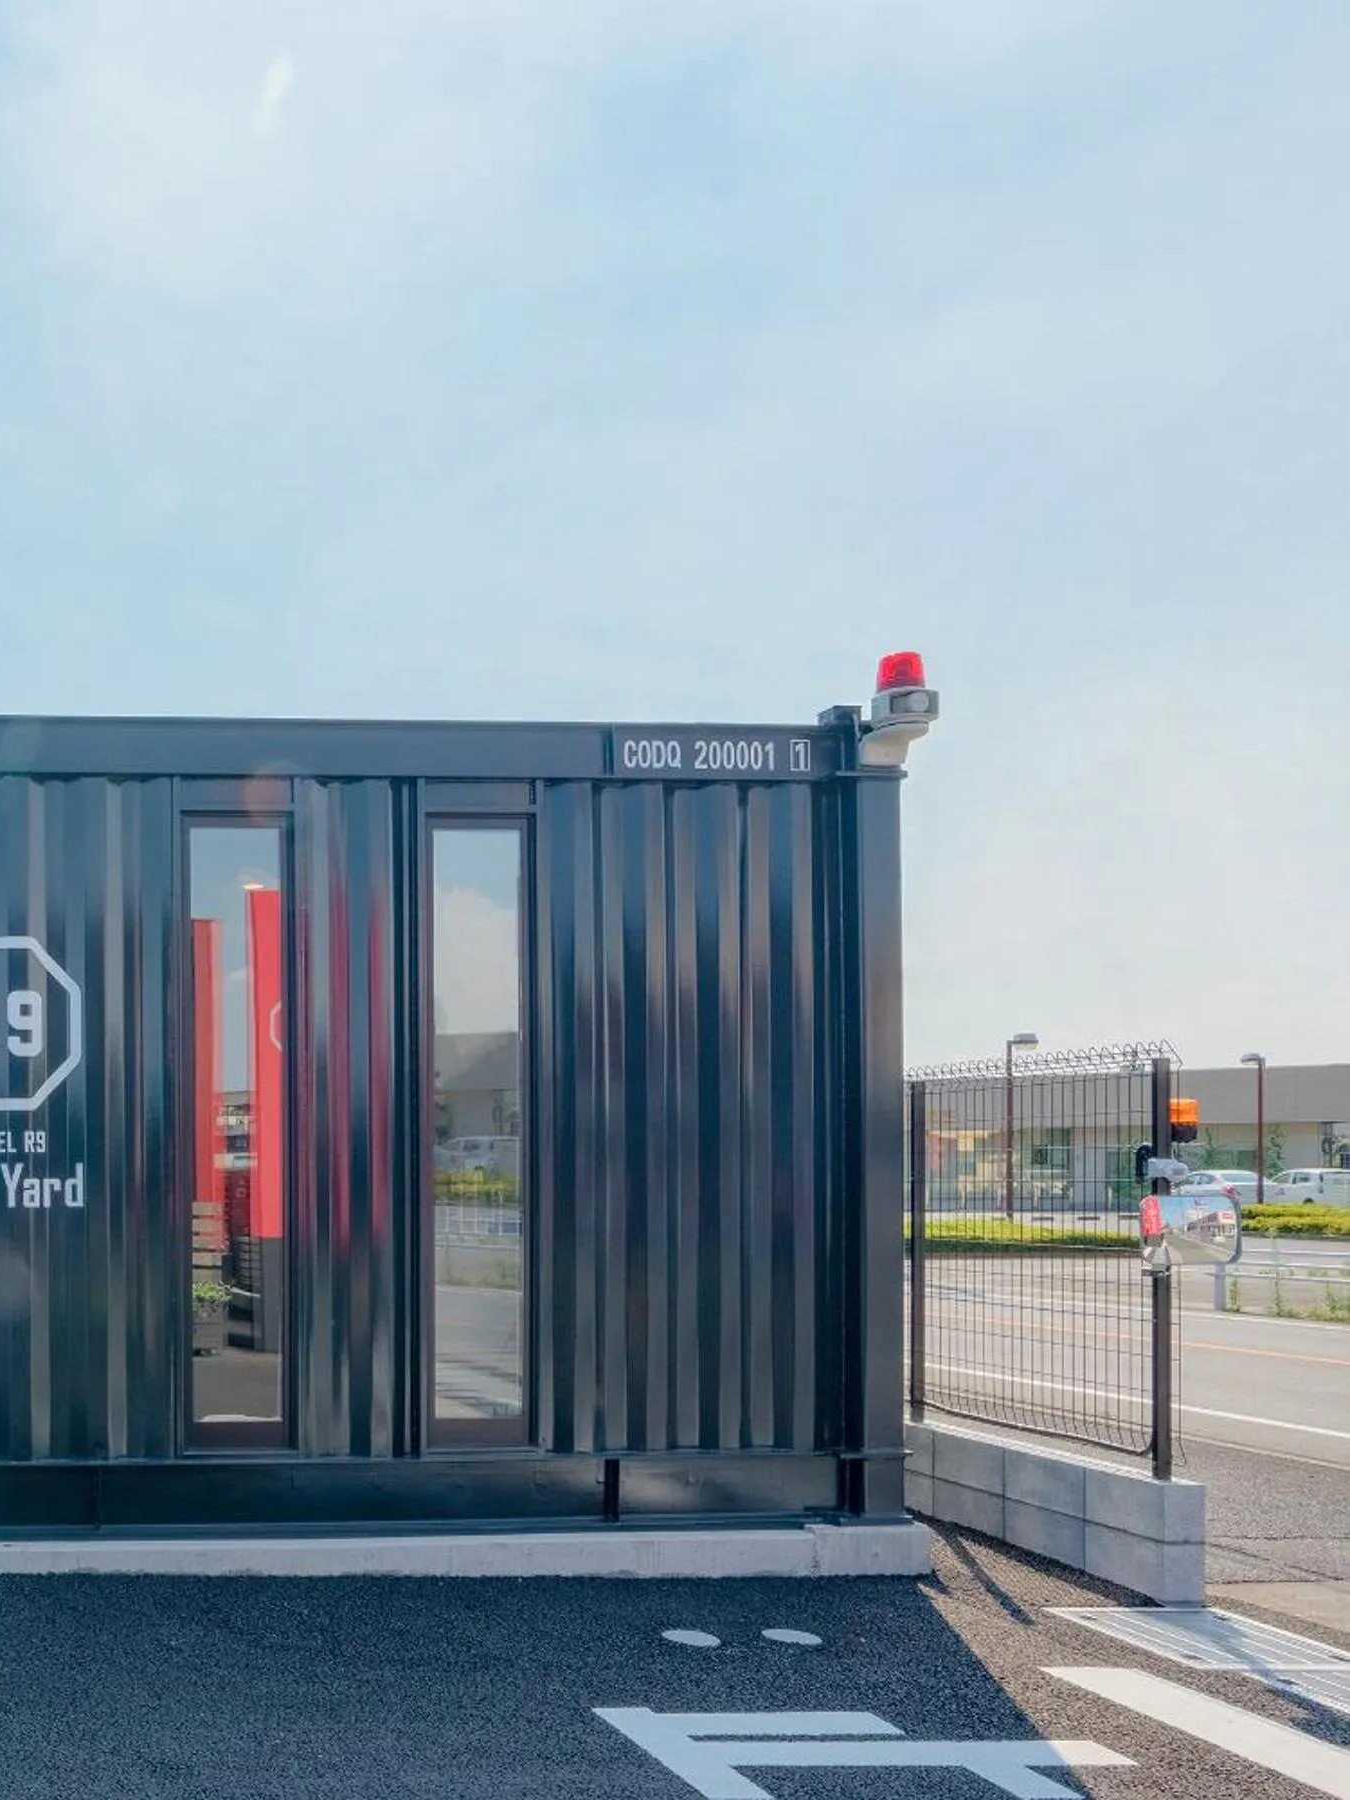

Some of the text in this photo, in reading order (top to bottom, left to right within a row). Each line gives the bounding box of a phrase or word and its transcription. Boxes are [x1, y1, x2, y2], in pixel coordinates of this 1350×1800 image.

[623, 740, 808, 771] CODQ 200001 1
[24, 1131, 46, 1153] R9
[0, 1162, 85, 1209] Yard
